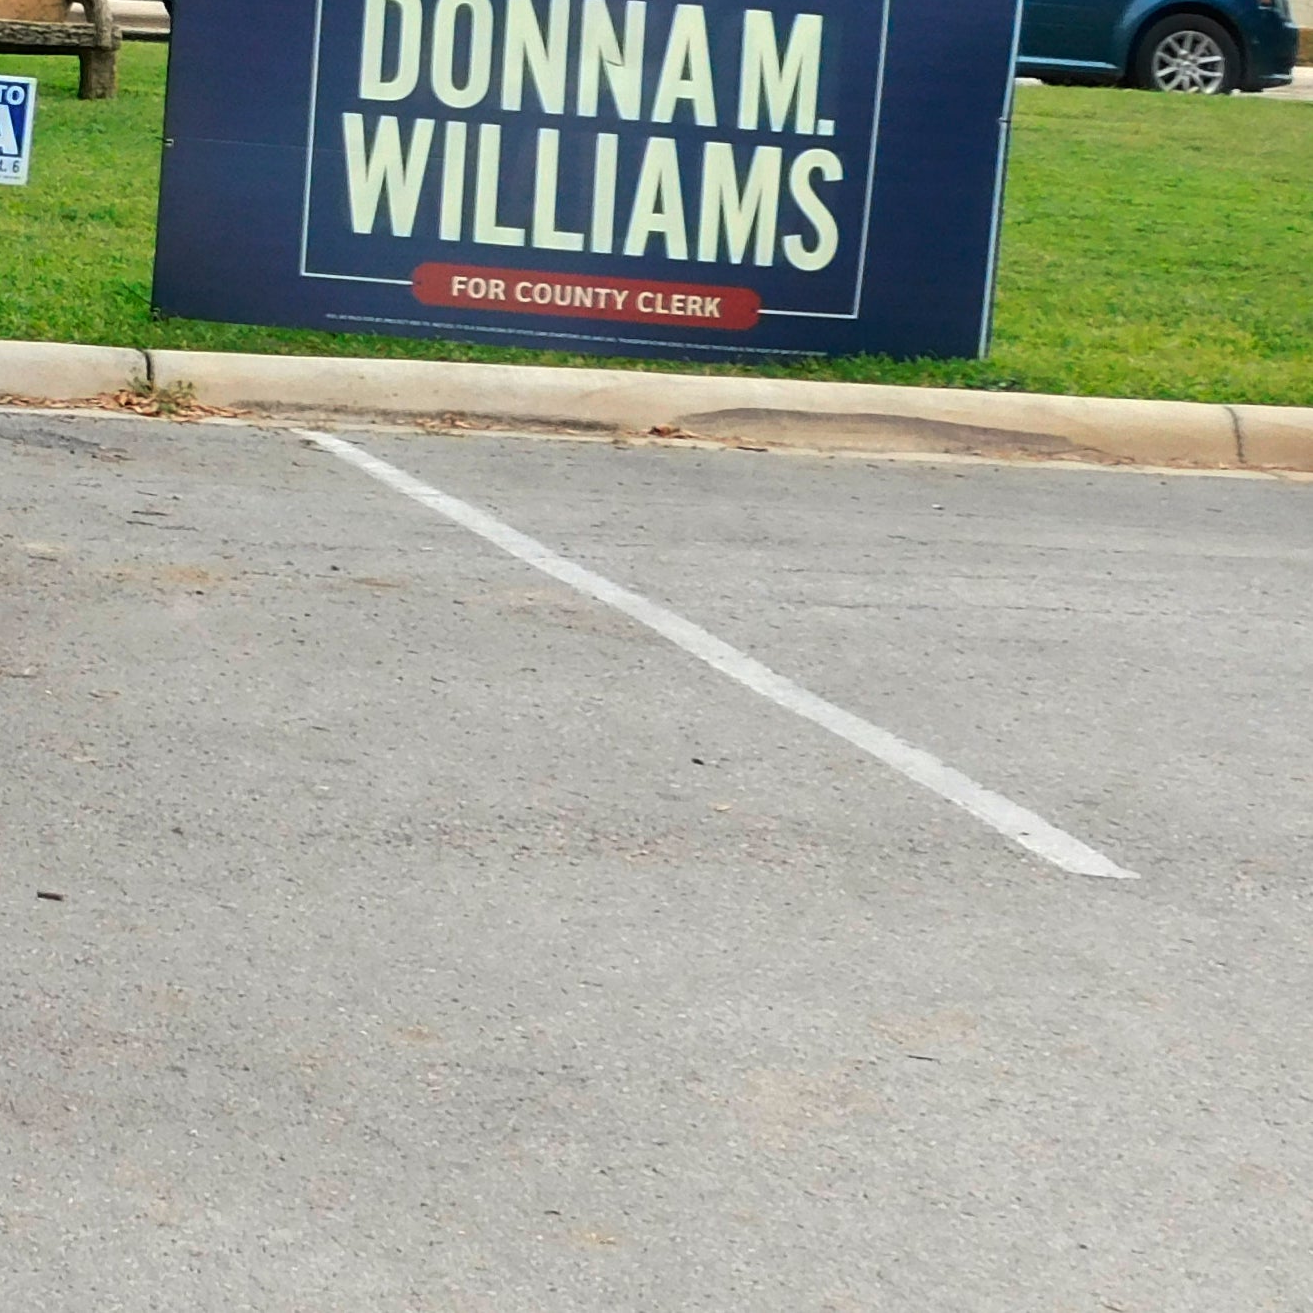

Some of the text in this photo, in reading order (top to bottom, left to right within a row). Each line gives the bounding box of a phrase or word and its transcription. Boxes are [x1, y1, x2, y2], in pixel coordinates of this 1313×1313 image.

[738, 9, 836, 136] M.
[12, 160, 21, 173] 6
[343, 112, 843, 272] WILLIAMS
[451, 276, 721, 318] FOR COUNTY CLERK
